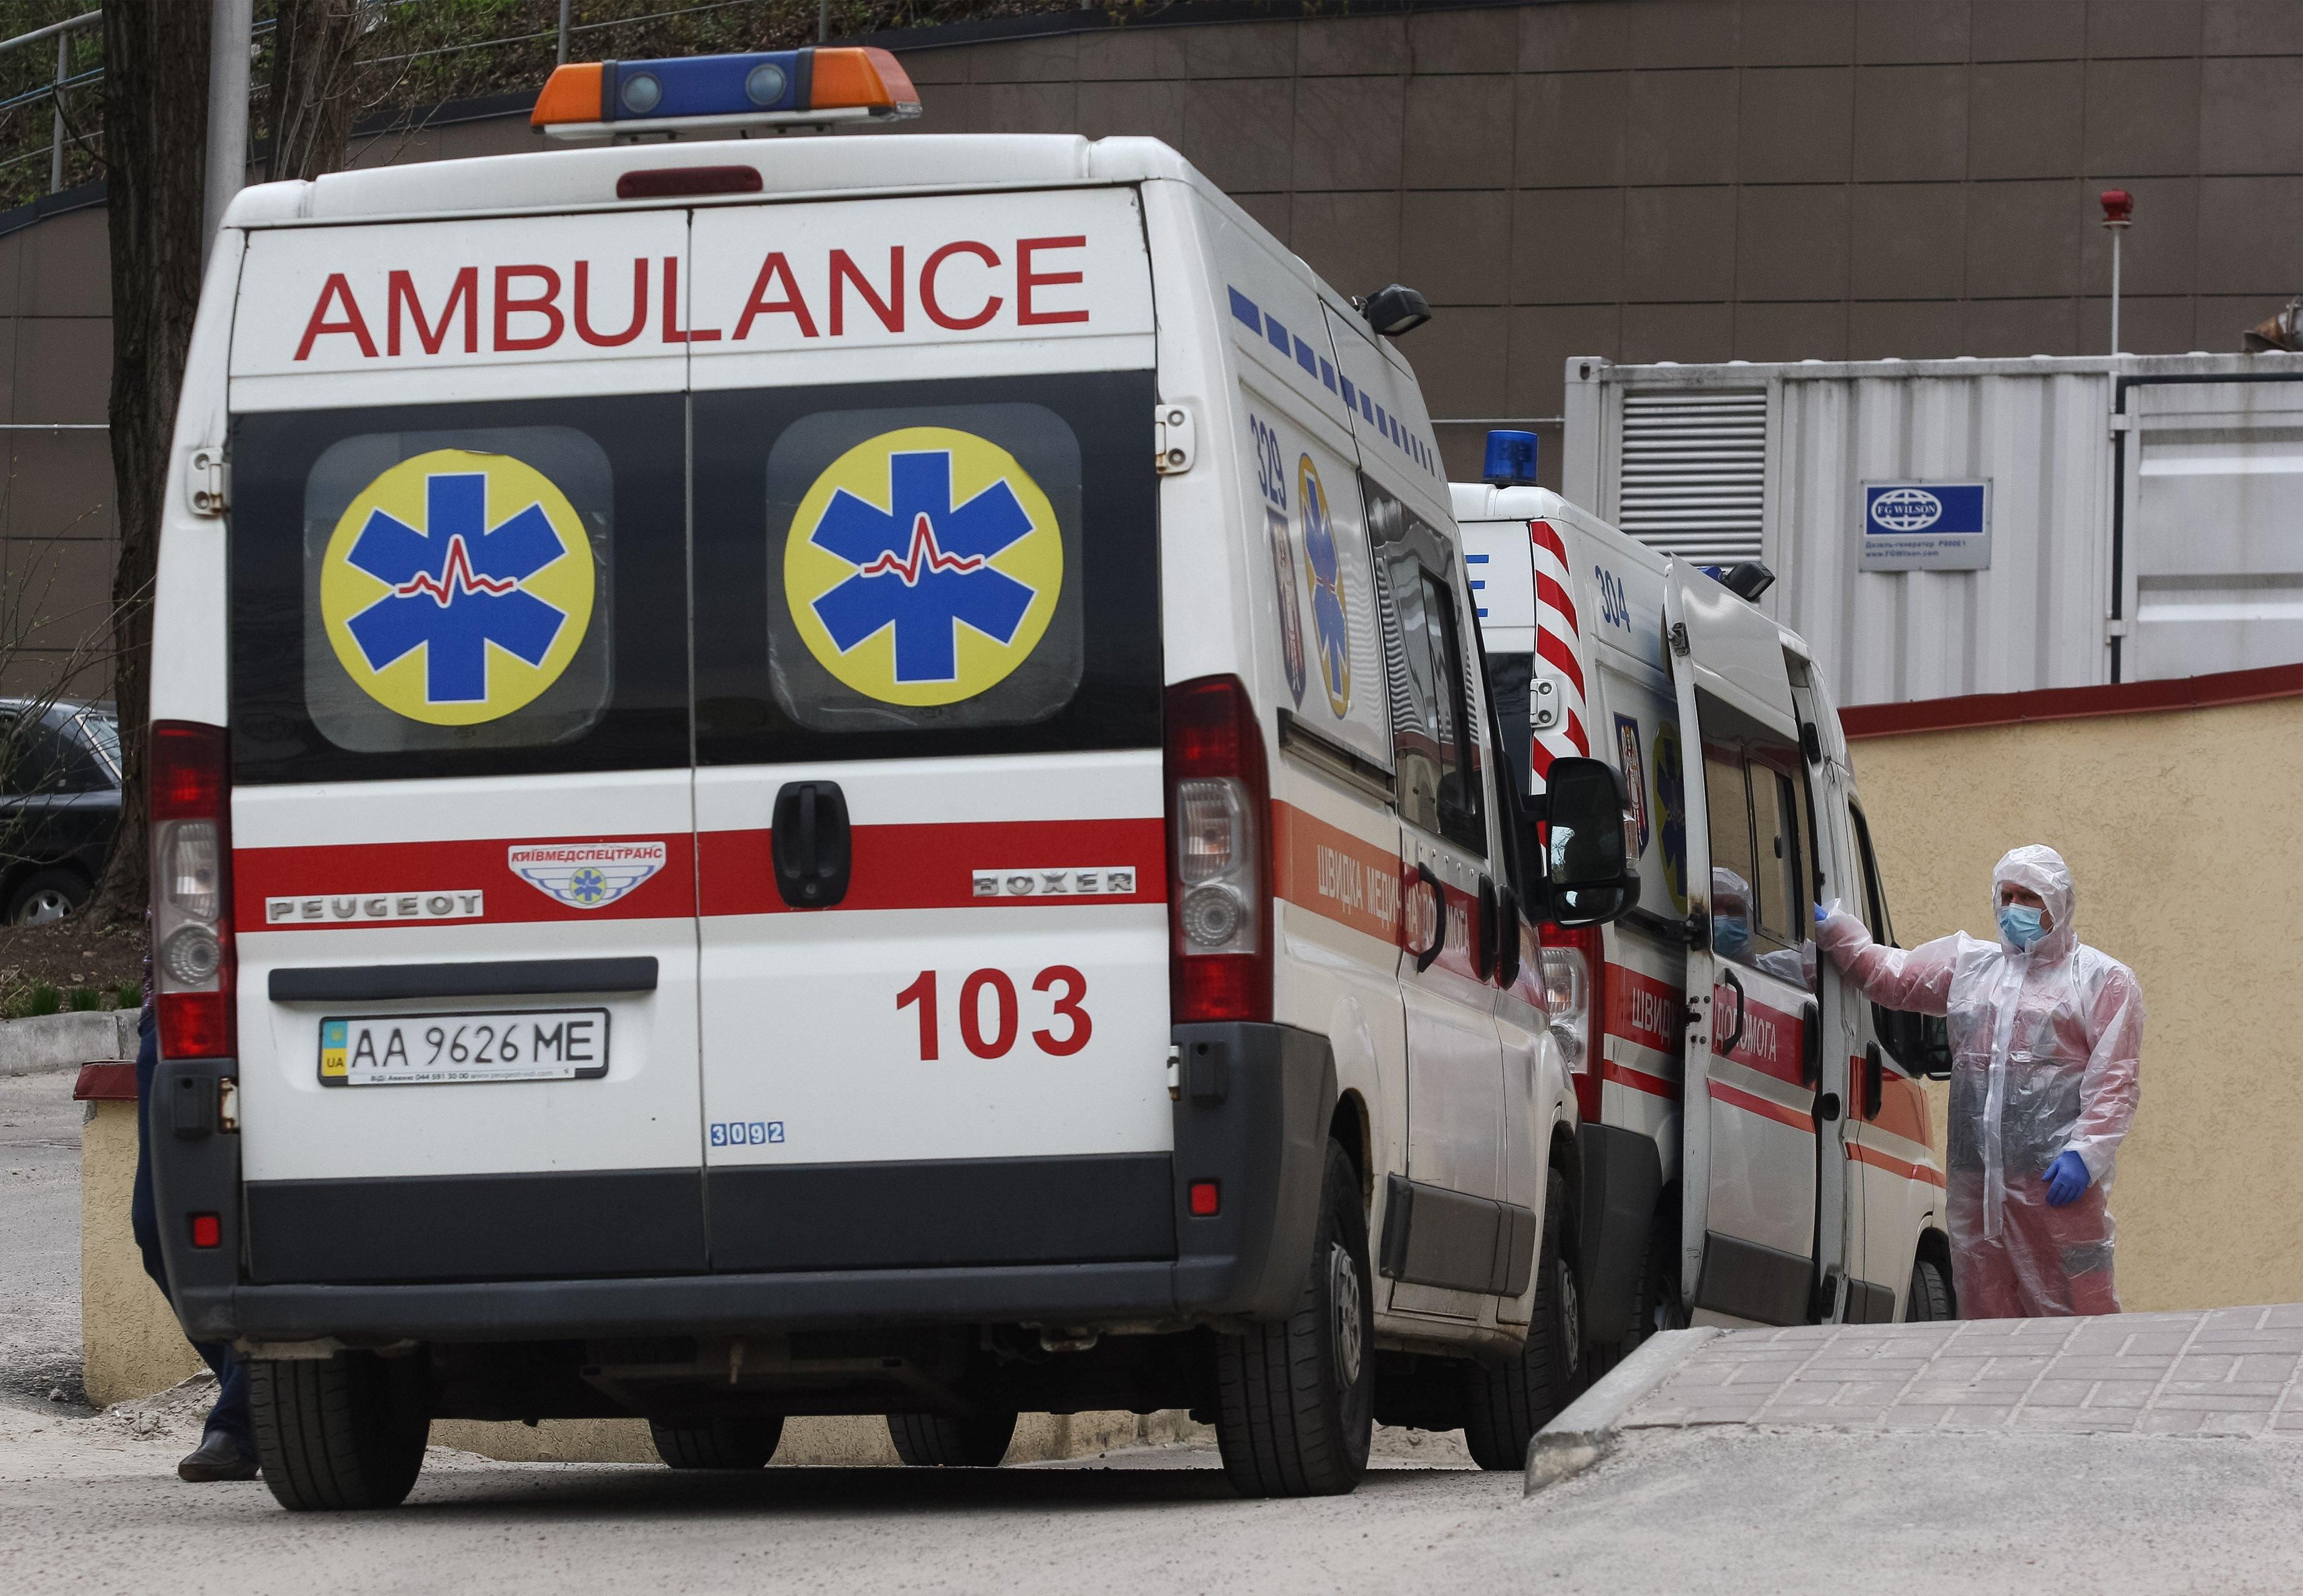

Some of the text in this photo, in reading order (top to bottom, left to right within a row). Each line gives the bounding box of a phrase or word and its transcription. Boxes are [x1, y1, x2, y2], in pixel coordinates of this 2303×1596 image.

[294, 235, 1089, 361] AMBULANCE
[1250, 413, 1287, 511] 329
[1877, 504, 1936, 514] FG WILSON
[1595, 565, 1631, 633] 304
[511, 847, 662, 863] КИЇВМЕДСПЕЦТРАНС
[973, 870, 1132, 896] BOXER
[1317, 844, 1364, 916] ШВИДКА
[268, 893, 481, 921] PEUGEOT
[896, 964, 1093, 1060] 103
[1631, 987, 1679, 1048] ШВИДК
[326, 1057, 345, 1068] UA
[351, 1021, 594, 1068] AA 9626 ME
[712, 1122, 783, 1145] 3092
